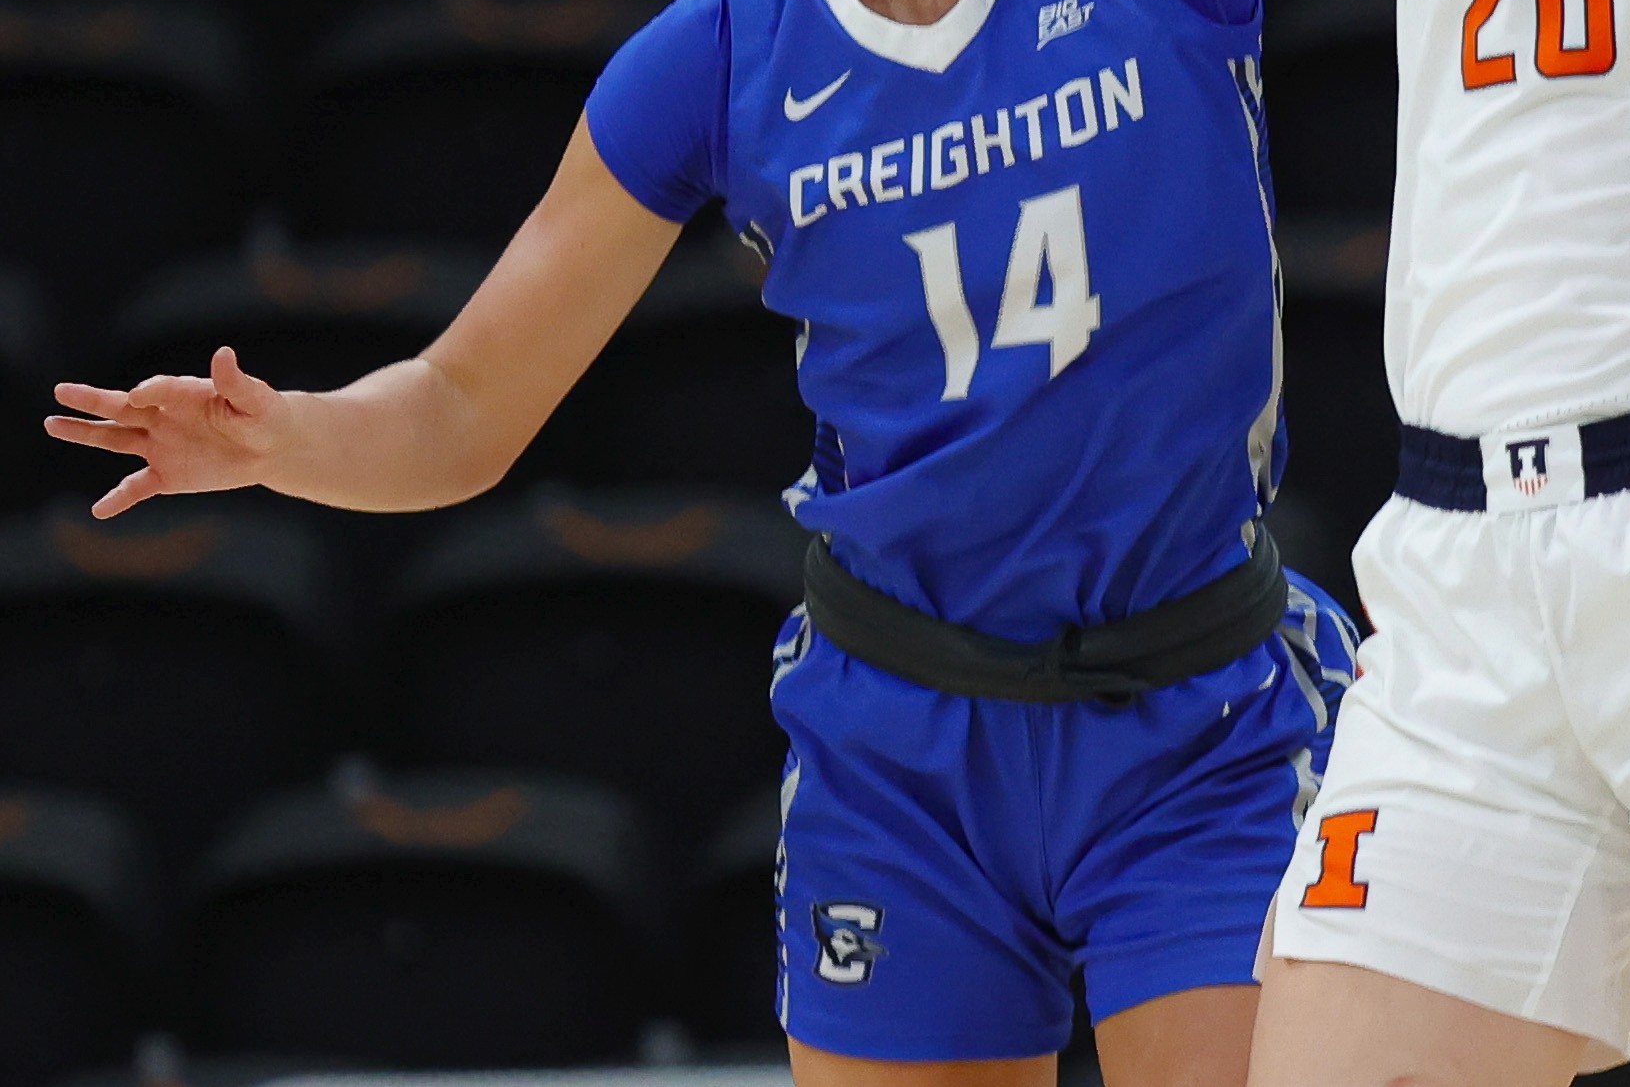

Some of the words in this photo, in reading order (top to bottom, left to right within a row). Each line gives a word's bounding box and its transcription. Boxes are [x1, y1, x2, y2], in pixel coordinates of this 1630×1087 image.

[788, 57, 1144, 228] CREIGHTON
[902, 184, 1101, 401] 14
[1299, 809, 1378, 909] I
